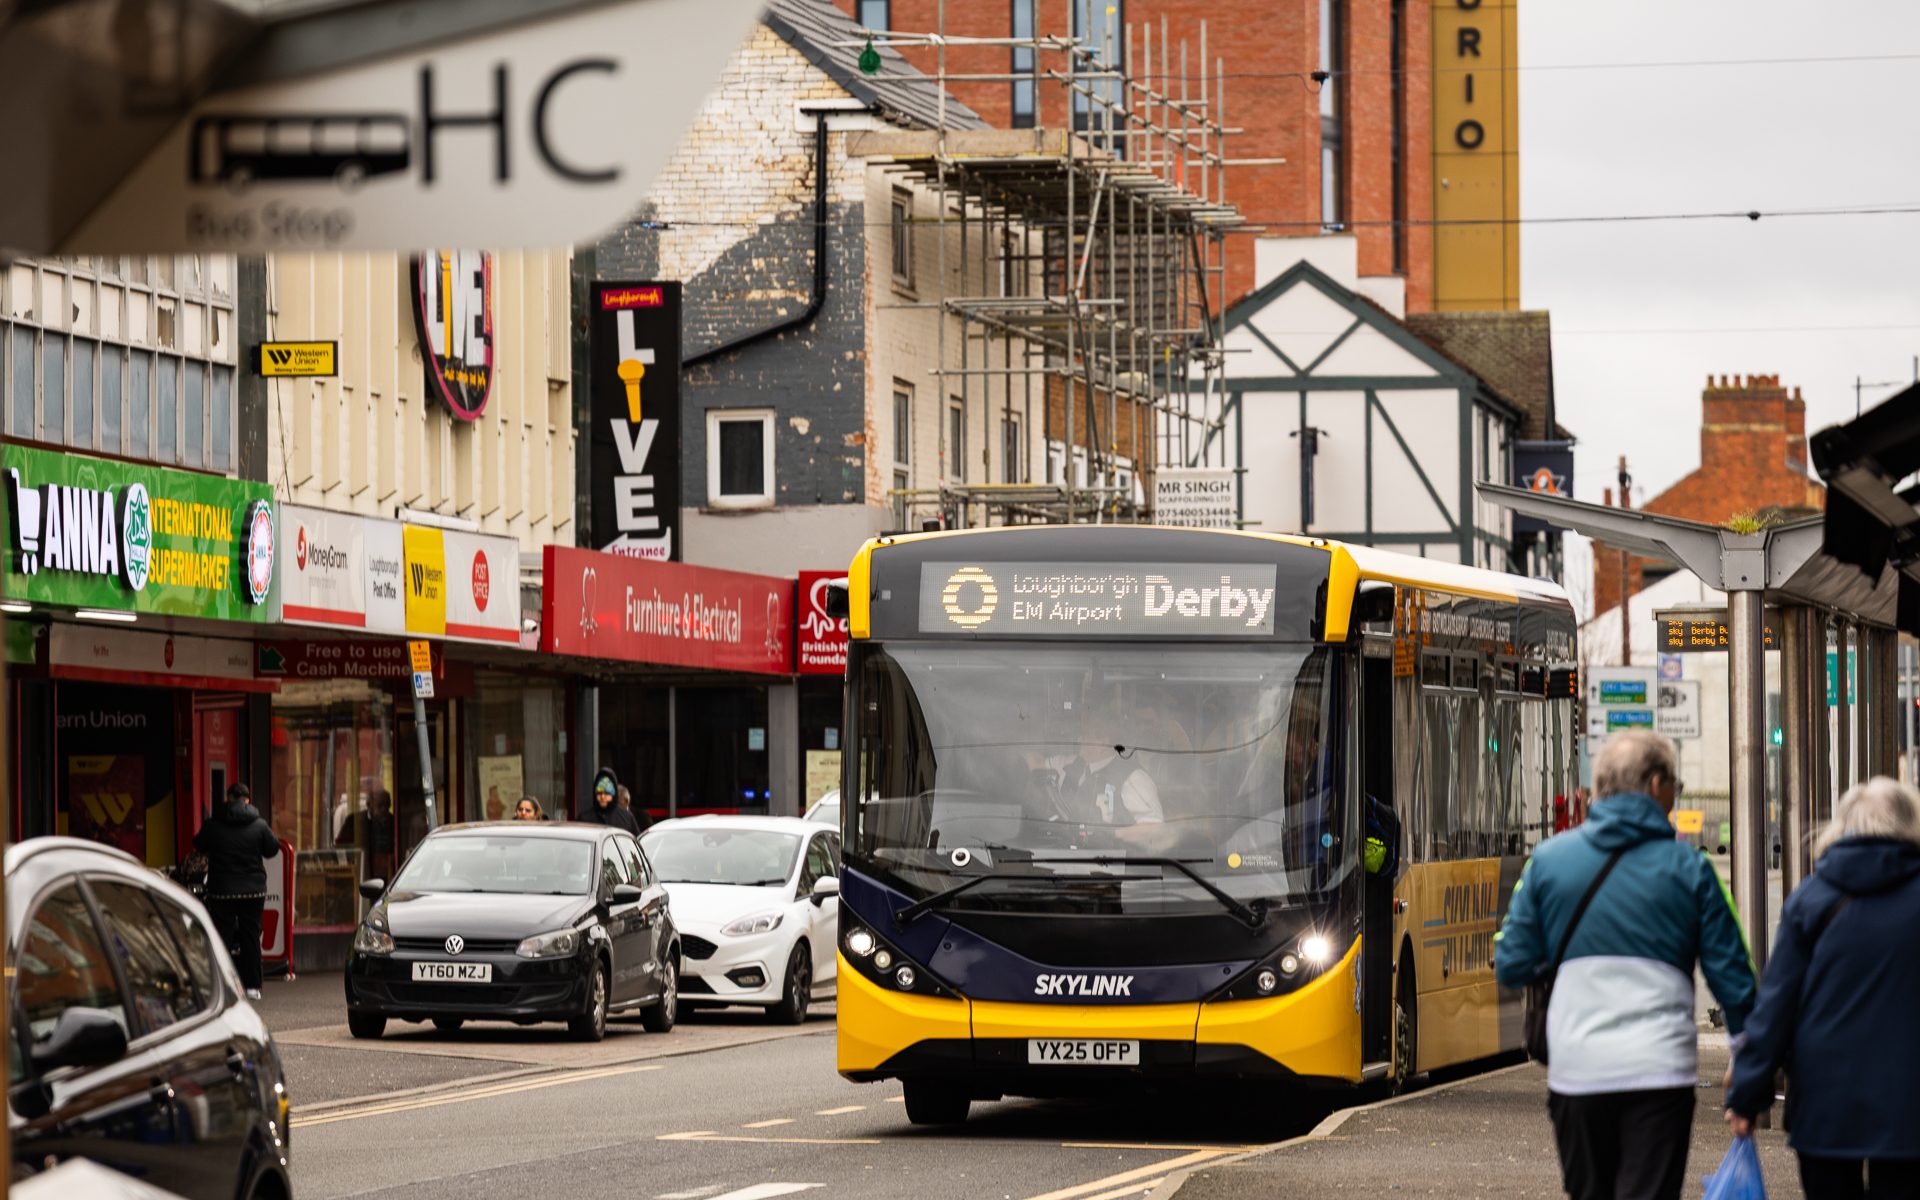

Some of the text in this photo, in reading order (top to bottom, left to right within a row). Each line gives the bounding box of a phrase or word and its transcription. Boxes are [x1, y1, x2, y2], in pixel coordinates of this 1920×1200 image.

[419, 59, 622, 187] HC
[604, 288, 660, 307] Loughborough
[294, 349, 329, 357] Western
[294, 357, 319, 366] Union
[1158, 480, 1231, 494] MR SINGH
[44, 483, 119, 575] ANNA
[149, 496, 234, 543] NTERNATIONAL
[611, 544, 665, 557] Entrance
[148, 548, 230, 592] SUPERMARKET
[369, 554, 399, 579] Loughborough
[424, 563, 443, 583] Western
[475, 563, 487, 580] POST
[373, 580, 397, 600] Post Office
[424, 585, 438, 600] Union
[473, 583, 488, 601] OFFICE
[1144, 575, 1274, 626] Derby
[626, 585, 742, 644] Furniture & Electrical
[1012, 601, 1122, 625] EM Airport
[306, 643, 341, 659] Free
[349, 643, 365, 659] to
[372, 645, 401, 660] use
[803, 642, 838, 652] British
[297, 661, 410, 678] Cash Machine
[90, 709, 147, 729] Union
[418, 964, 487, 979] YT60 MZJ
[1034, 973, 1134, 996] SKYLINK
[1036, 1041, 1131, 1061] YX25 OFP
